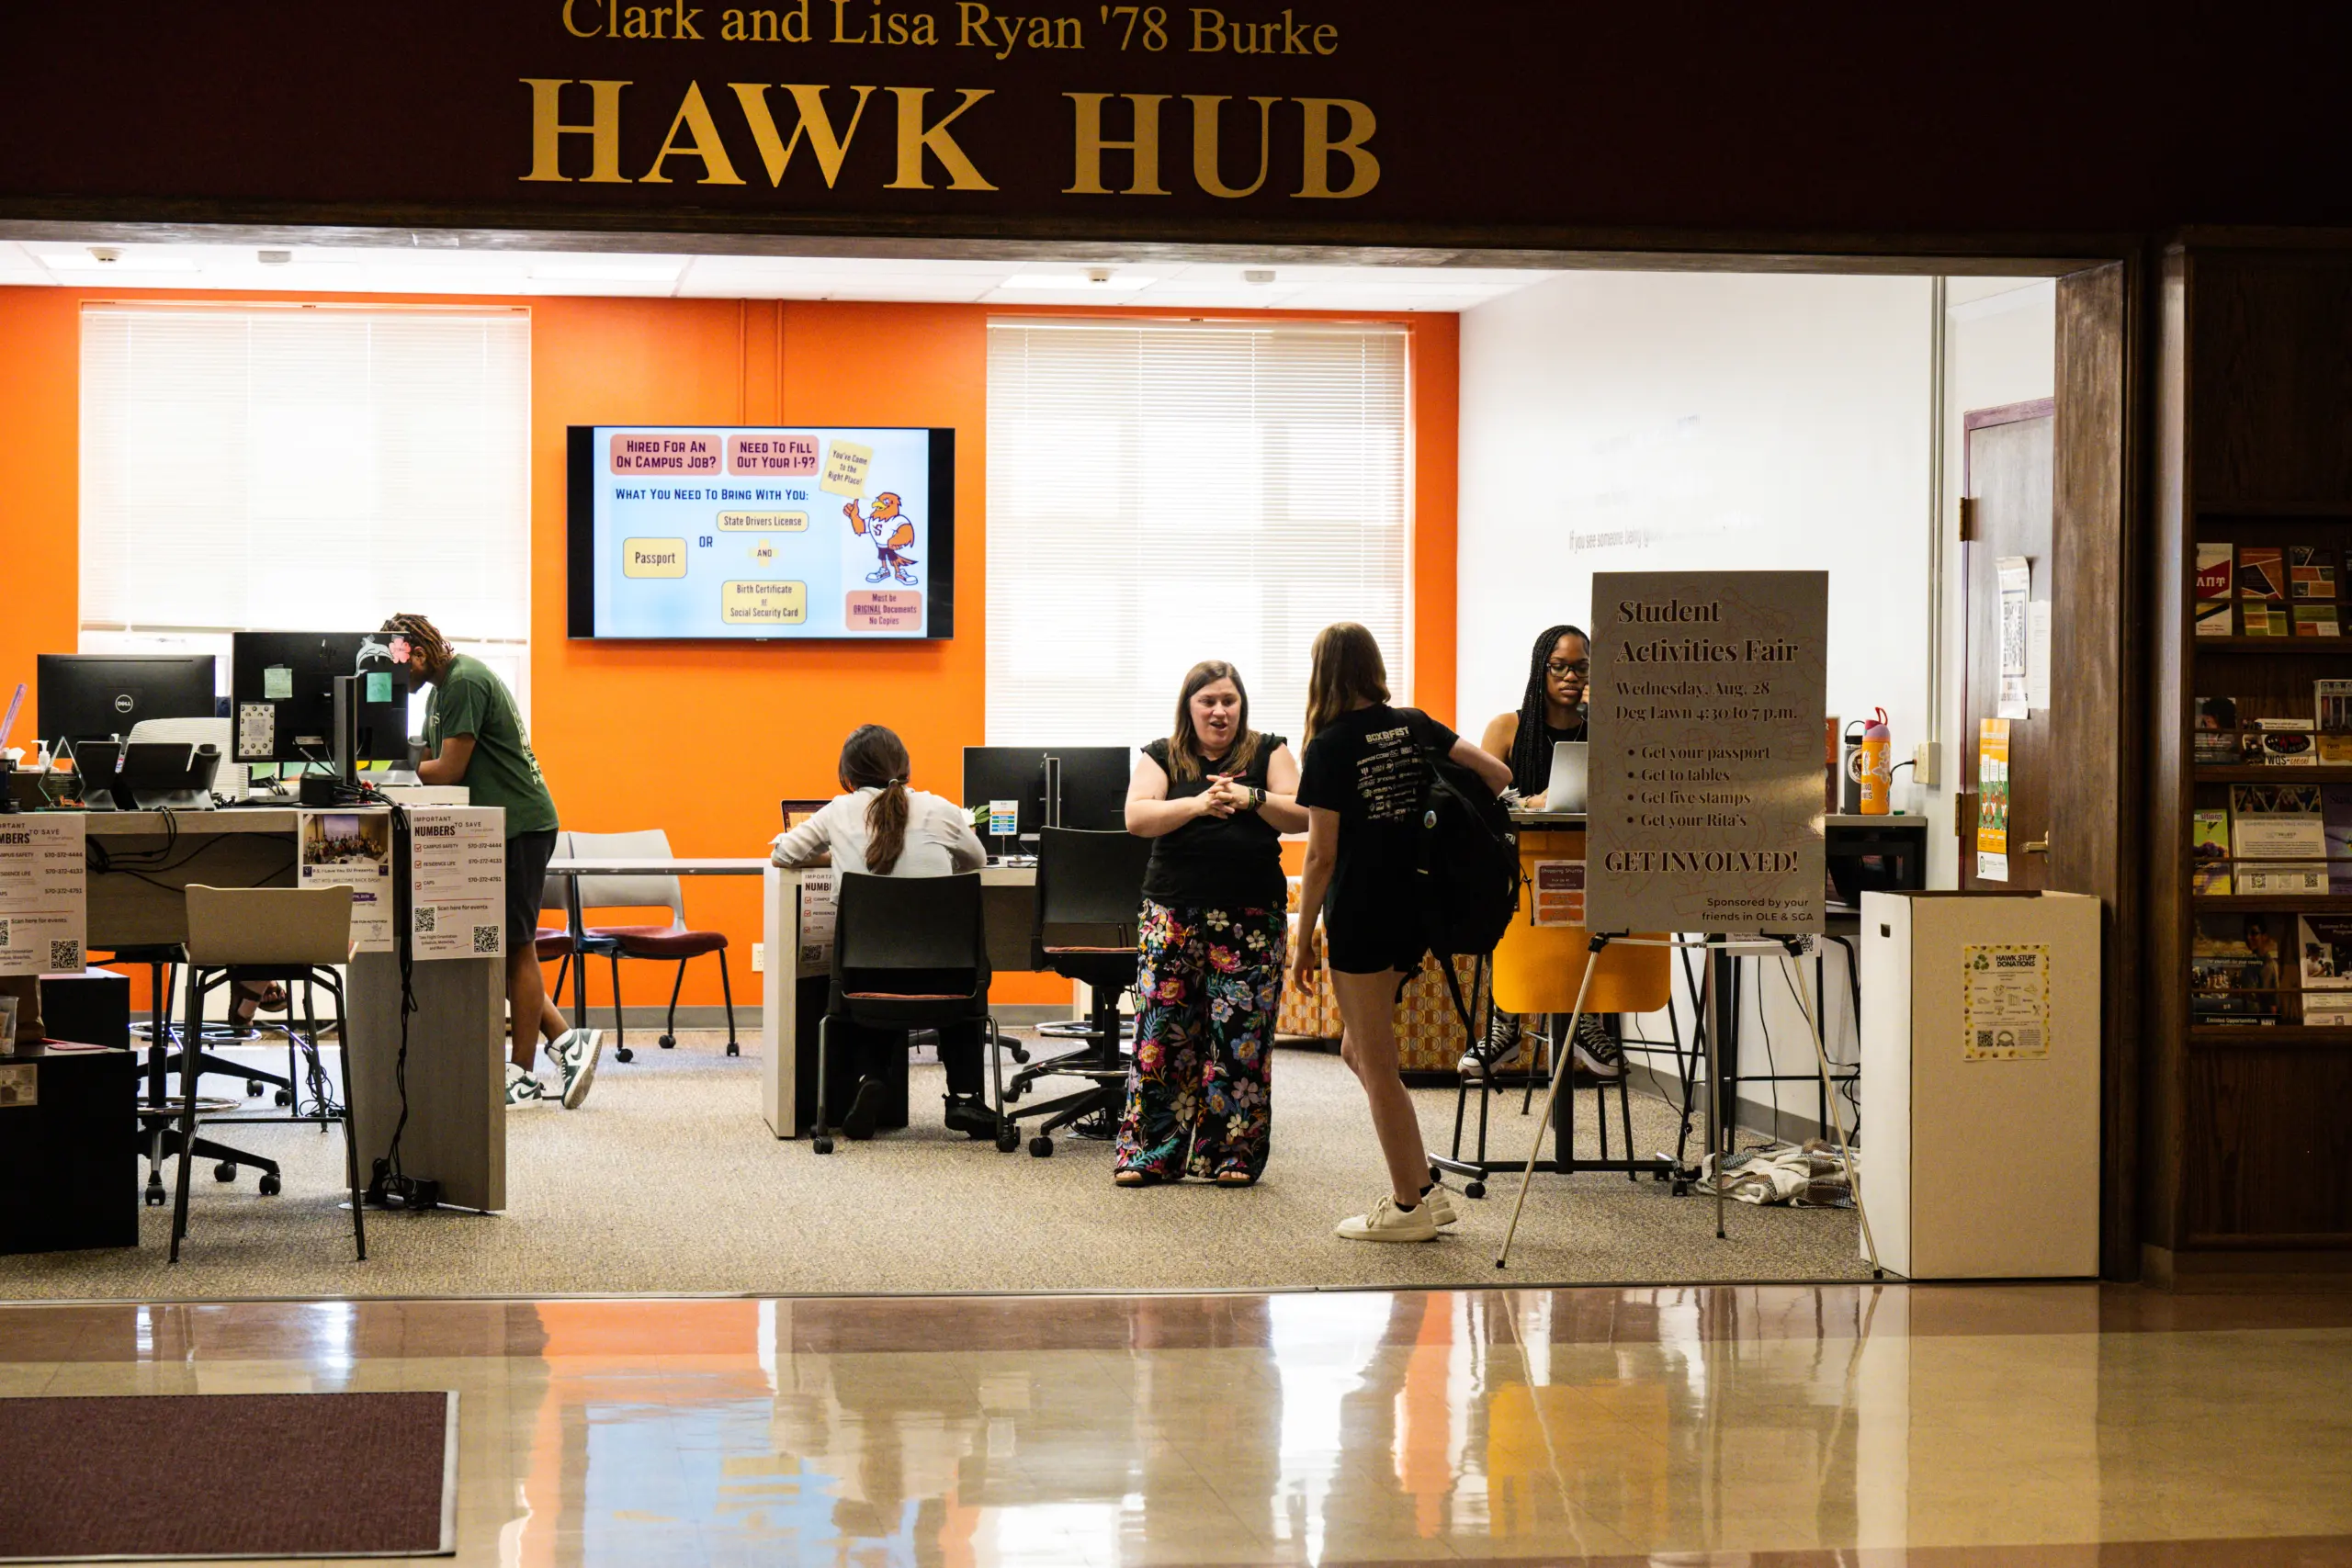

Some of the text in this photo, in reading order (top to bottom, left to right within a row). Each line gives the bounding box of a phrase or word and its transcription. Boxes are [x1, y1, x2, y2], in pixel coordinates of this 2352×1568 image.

[562, 0, 1339, 60] Clark and Lisa Ryan '78 Burke
[518, 77, 1381, 198] HAWK HUB
[741, 441, 812, 453] NEED TO FILL
[636, 456, 683, 468] CAMPUS
[687, 457, 716, 468] JOB?
[738, 456, 758, 468] OUT
[762, 457, 790, 468] YOUR
[851, 454, 867, 466] Come
[840, 463, 857, 474] to the
[828, 471, 842, 483] Right
[616, 490, 646, 500] WHAT
[650, 490, 671, 500] YOU
[674, 490, 701, 500] NEED
[706, 490, 718, 500] TO
[721, 490, 752, 501] BRING
[756, 490, 781, 501] WITH
[724, 515, 802, 526] State Drivers License
[699, 536, 713, 547] OR
[635, 552, 675, 566] Passport
[757, 548, 772, 558] AND
[736, 584, 792, 594] Birth Certificate
[872, 593, 896, 603] Must be
[730, 607, 798, 619] Social Security Card
[854, 604, 917, 615] ORIGINAL Documents
[1617, 600, 1722, 624] Student
[869, 616, 899, 626] No Copies
[1615, 637, 1799, 663] Activities Fair
[1616, 681, 1770, 698] Wednesday, Aug. 28
[1615, 705, 1798, 723] Deg Lawn 4:30 to 7 p.m.
[1642, 745, 1770, 761] Get your passport
[1641, 768, 1730, 782] Get to tables
[1641, 790, 1751, 807] Get five stamps
[1641, 812, 1747, 829] Get your Rita's
[414, 826, 456, 836] NUMBERS
[1605, 851, 1798, 874] GET INVOLVED!
[1707, 897, 1808, 909] Sponsored by your
[1702, 911, 1814, 921] friends in OLE & SGA
